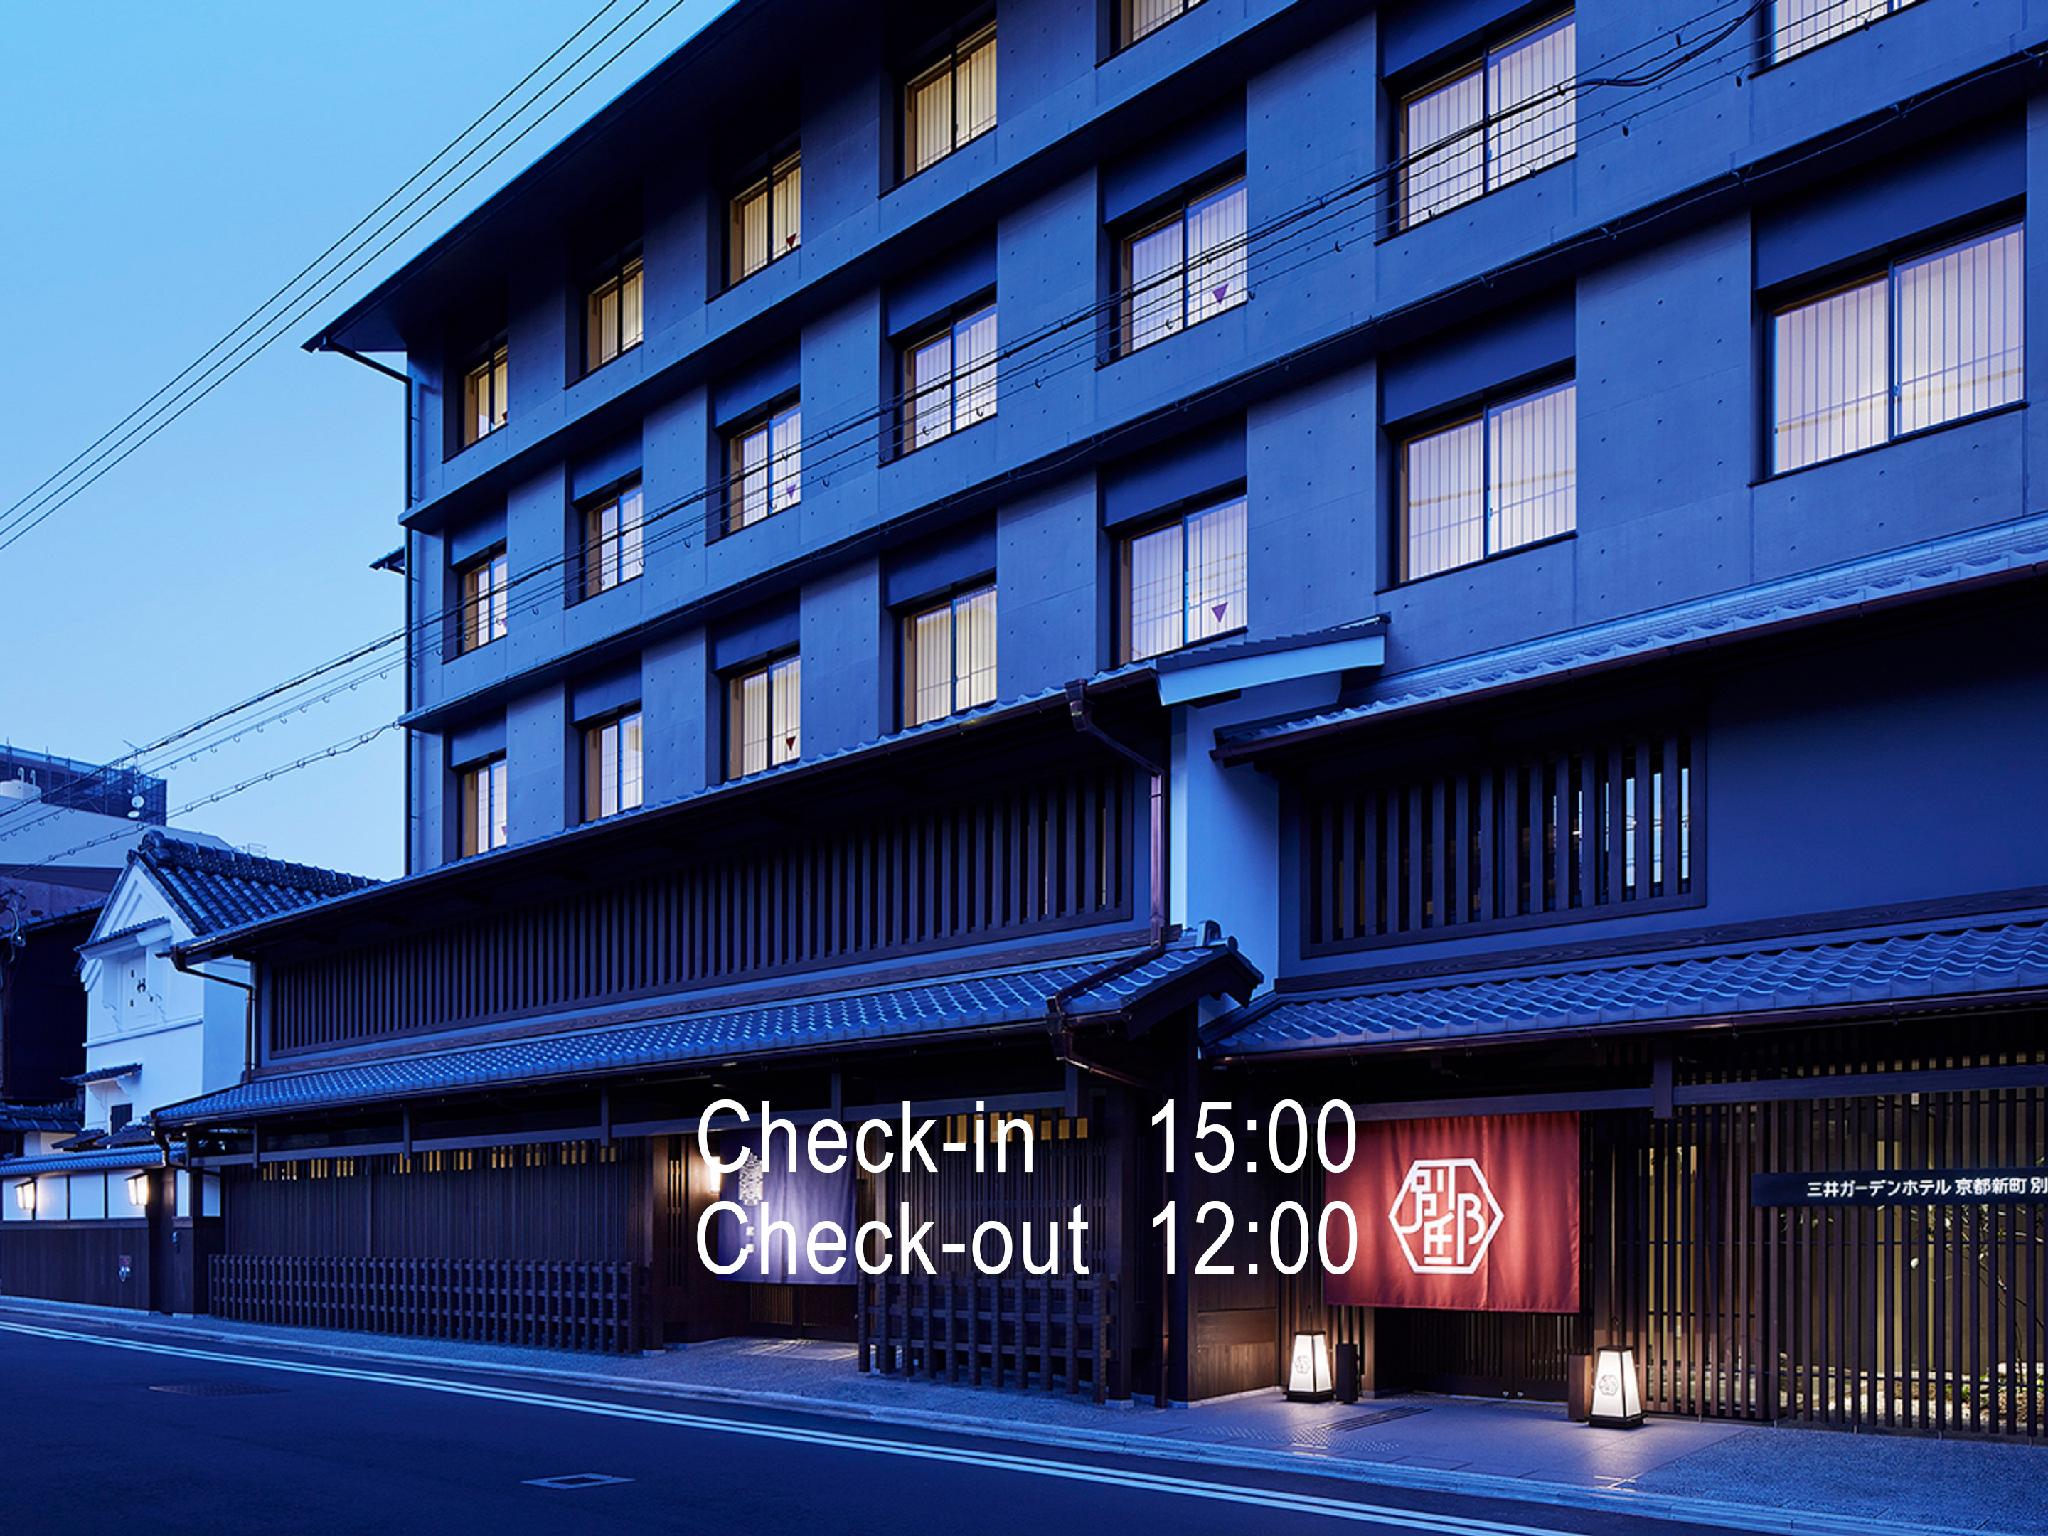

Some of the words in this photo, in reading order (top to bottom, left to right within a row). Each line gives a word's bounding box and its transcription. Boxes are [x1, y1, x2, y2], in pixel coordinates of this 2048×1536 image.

[1807, 1179, 1952, 1198] 三井ガーデンホテル
[1955, 1177, 2028, 1196] 京都新町
